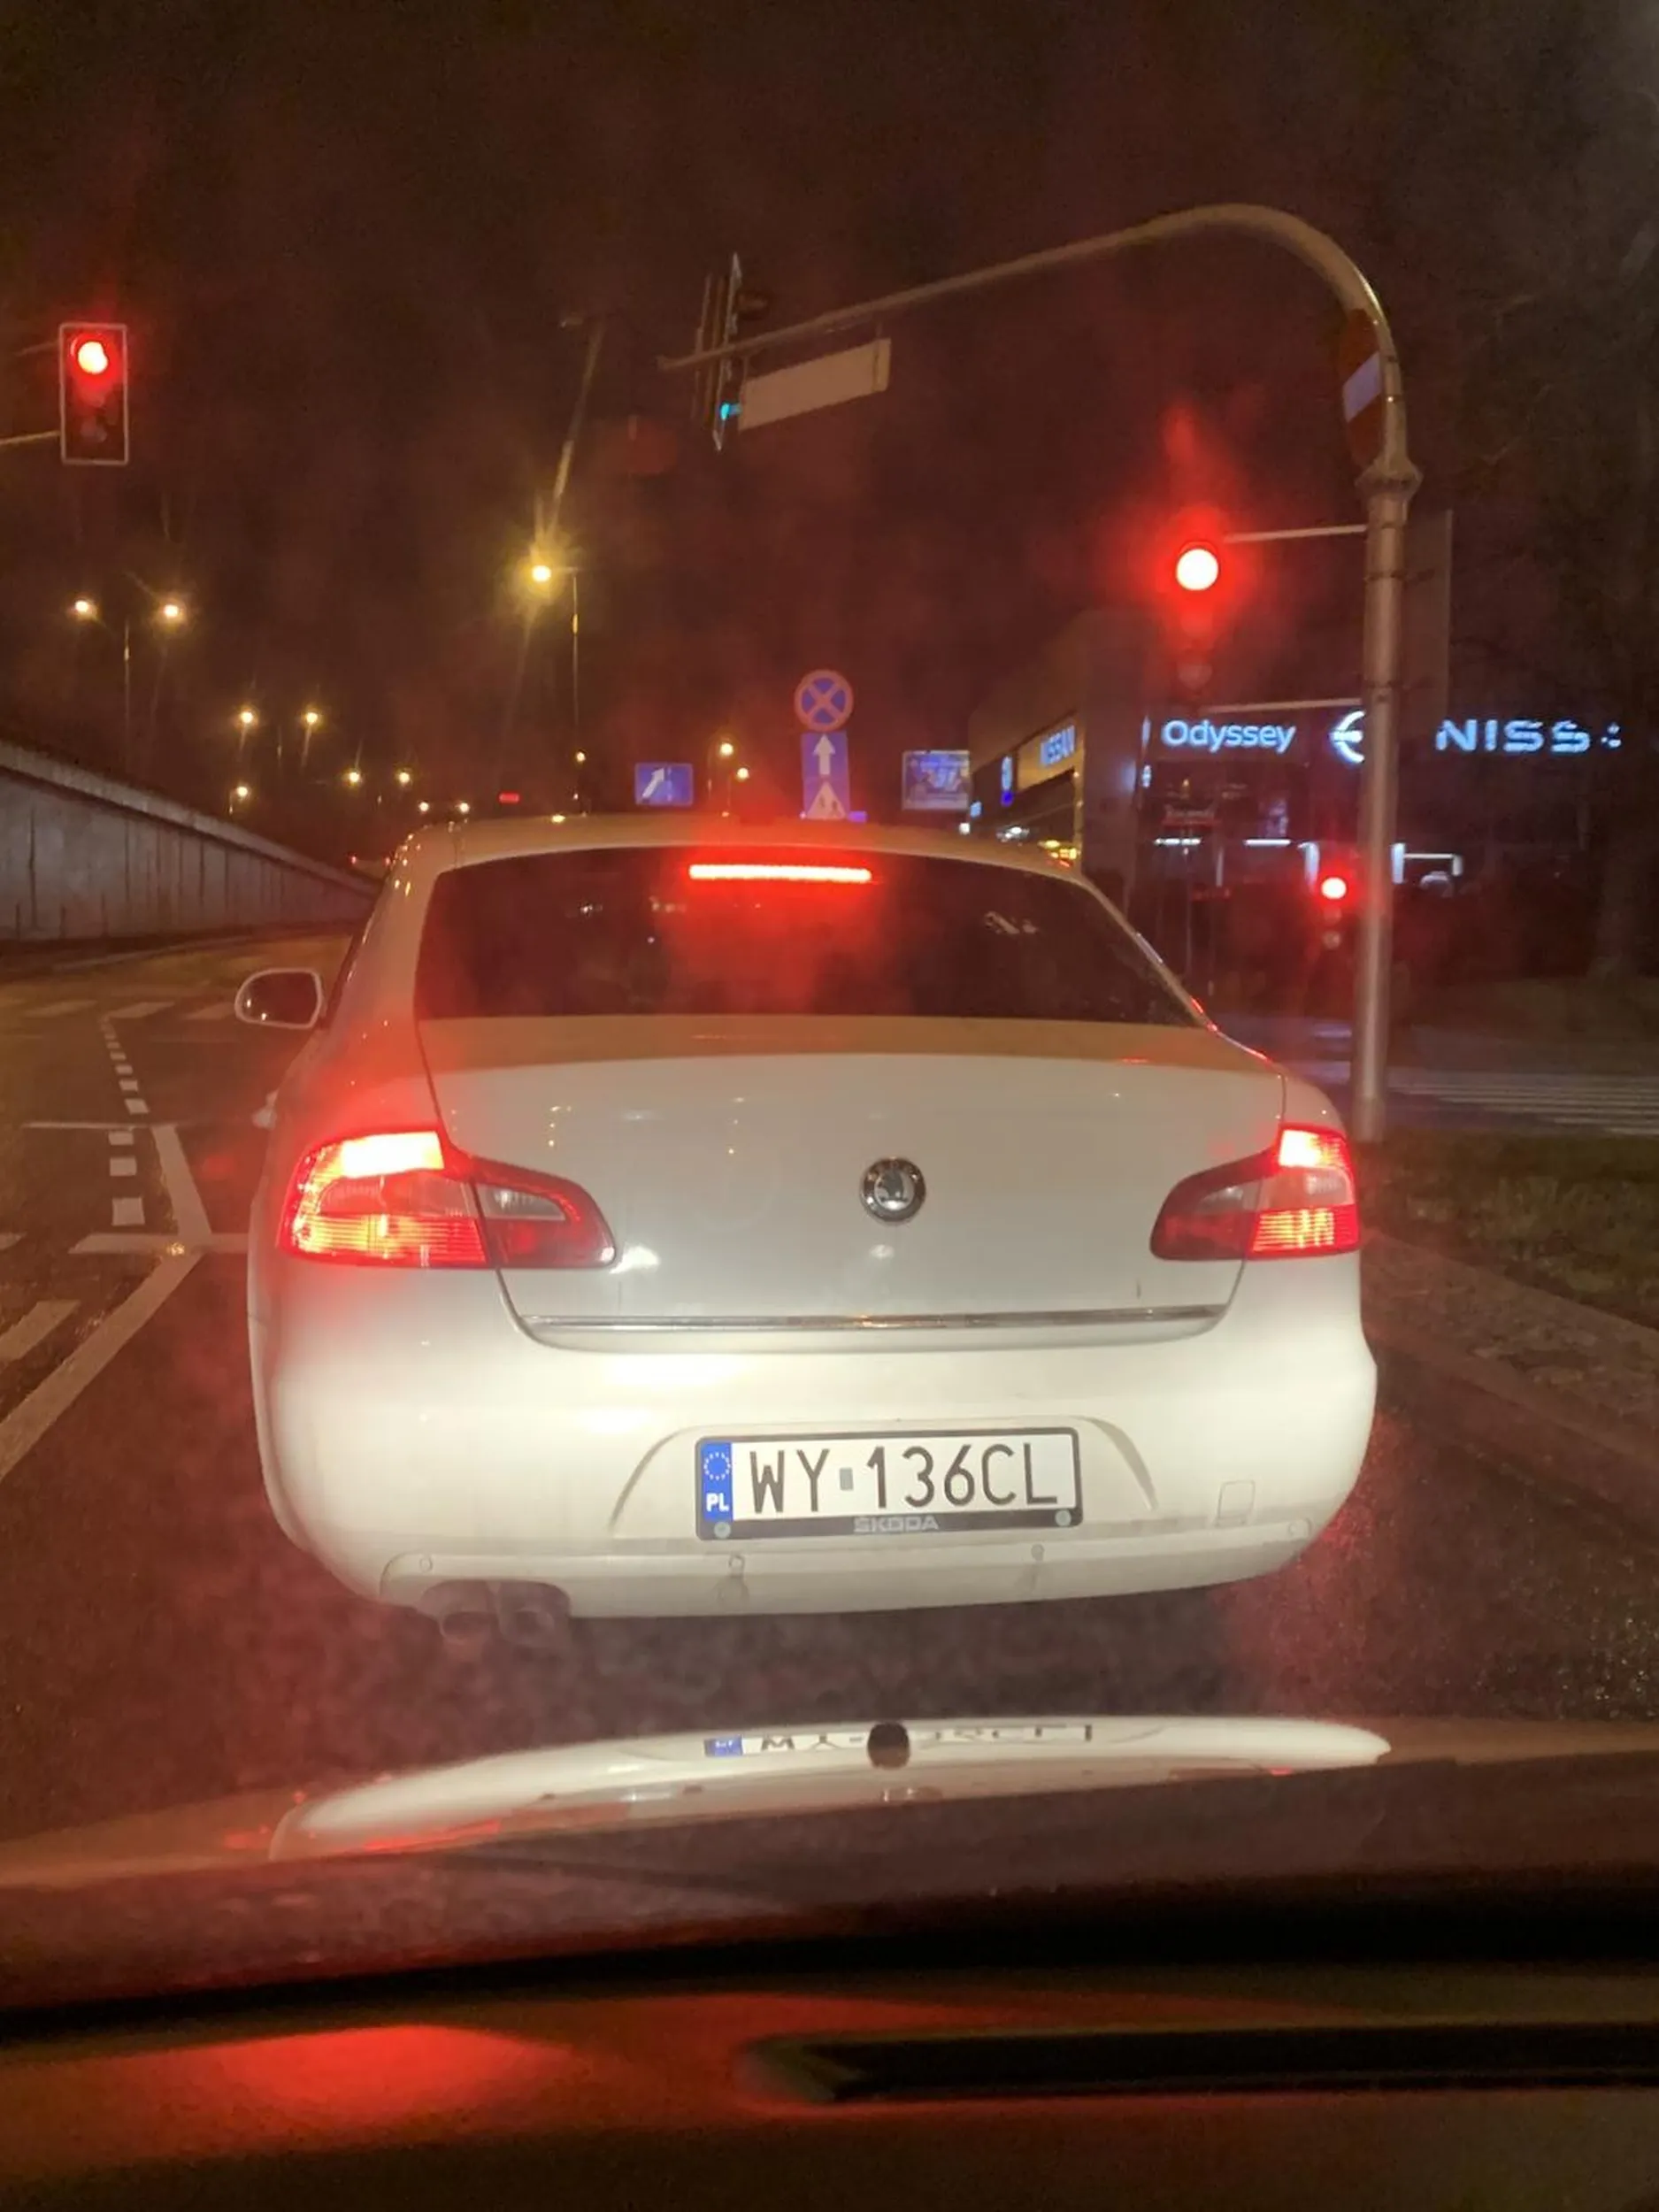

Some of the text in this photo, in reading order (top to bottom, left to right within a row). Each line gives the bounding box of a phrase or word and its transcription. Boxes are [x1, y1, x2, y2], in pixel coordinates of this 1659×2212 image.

[1162, 719, 1296, 753] Odyssey
[749, 1442, 1058, 1514] WY 136CL
[706, 1492, 730, 1512] PL
